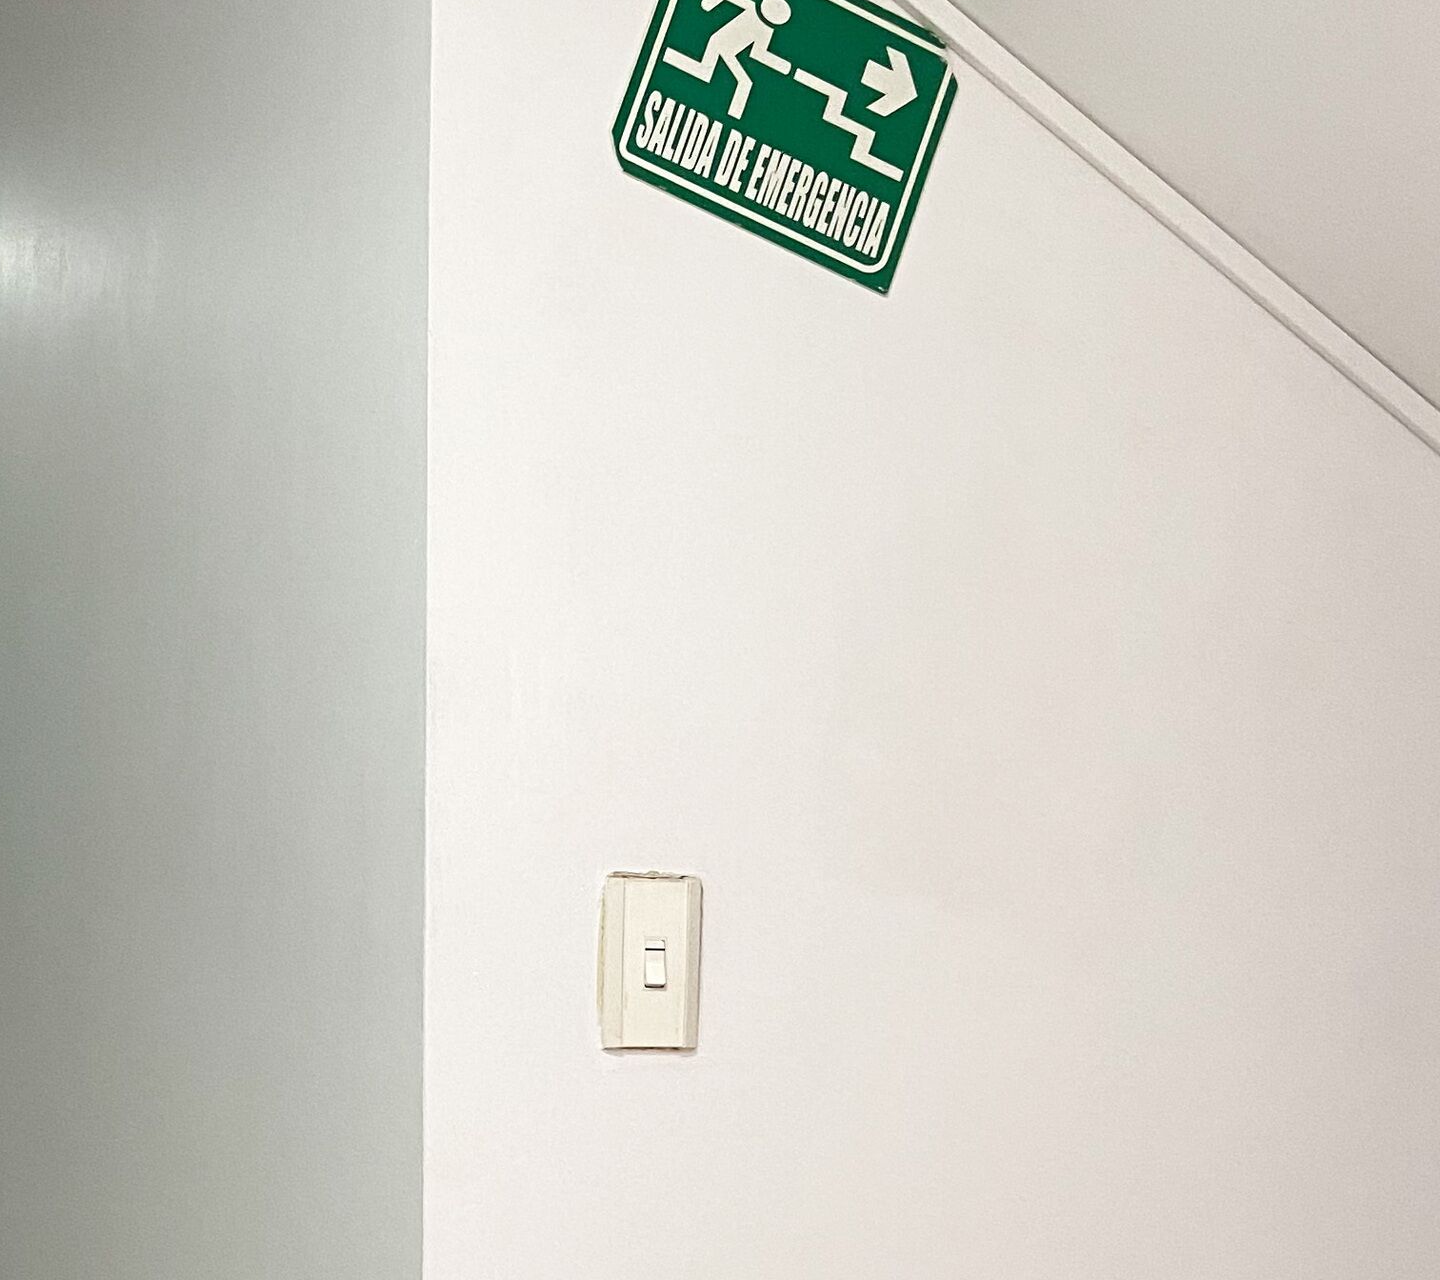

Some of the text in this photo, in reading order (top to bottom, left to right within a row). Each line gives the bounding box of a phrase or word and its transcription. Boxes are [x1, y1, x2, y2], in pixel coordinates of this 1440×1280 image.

[635, 90, 891, 258] SALIDA DE EMERGENCIA
